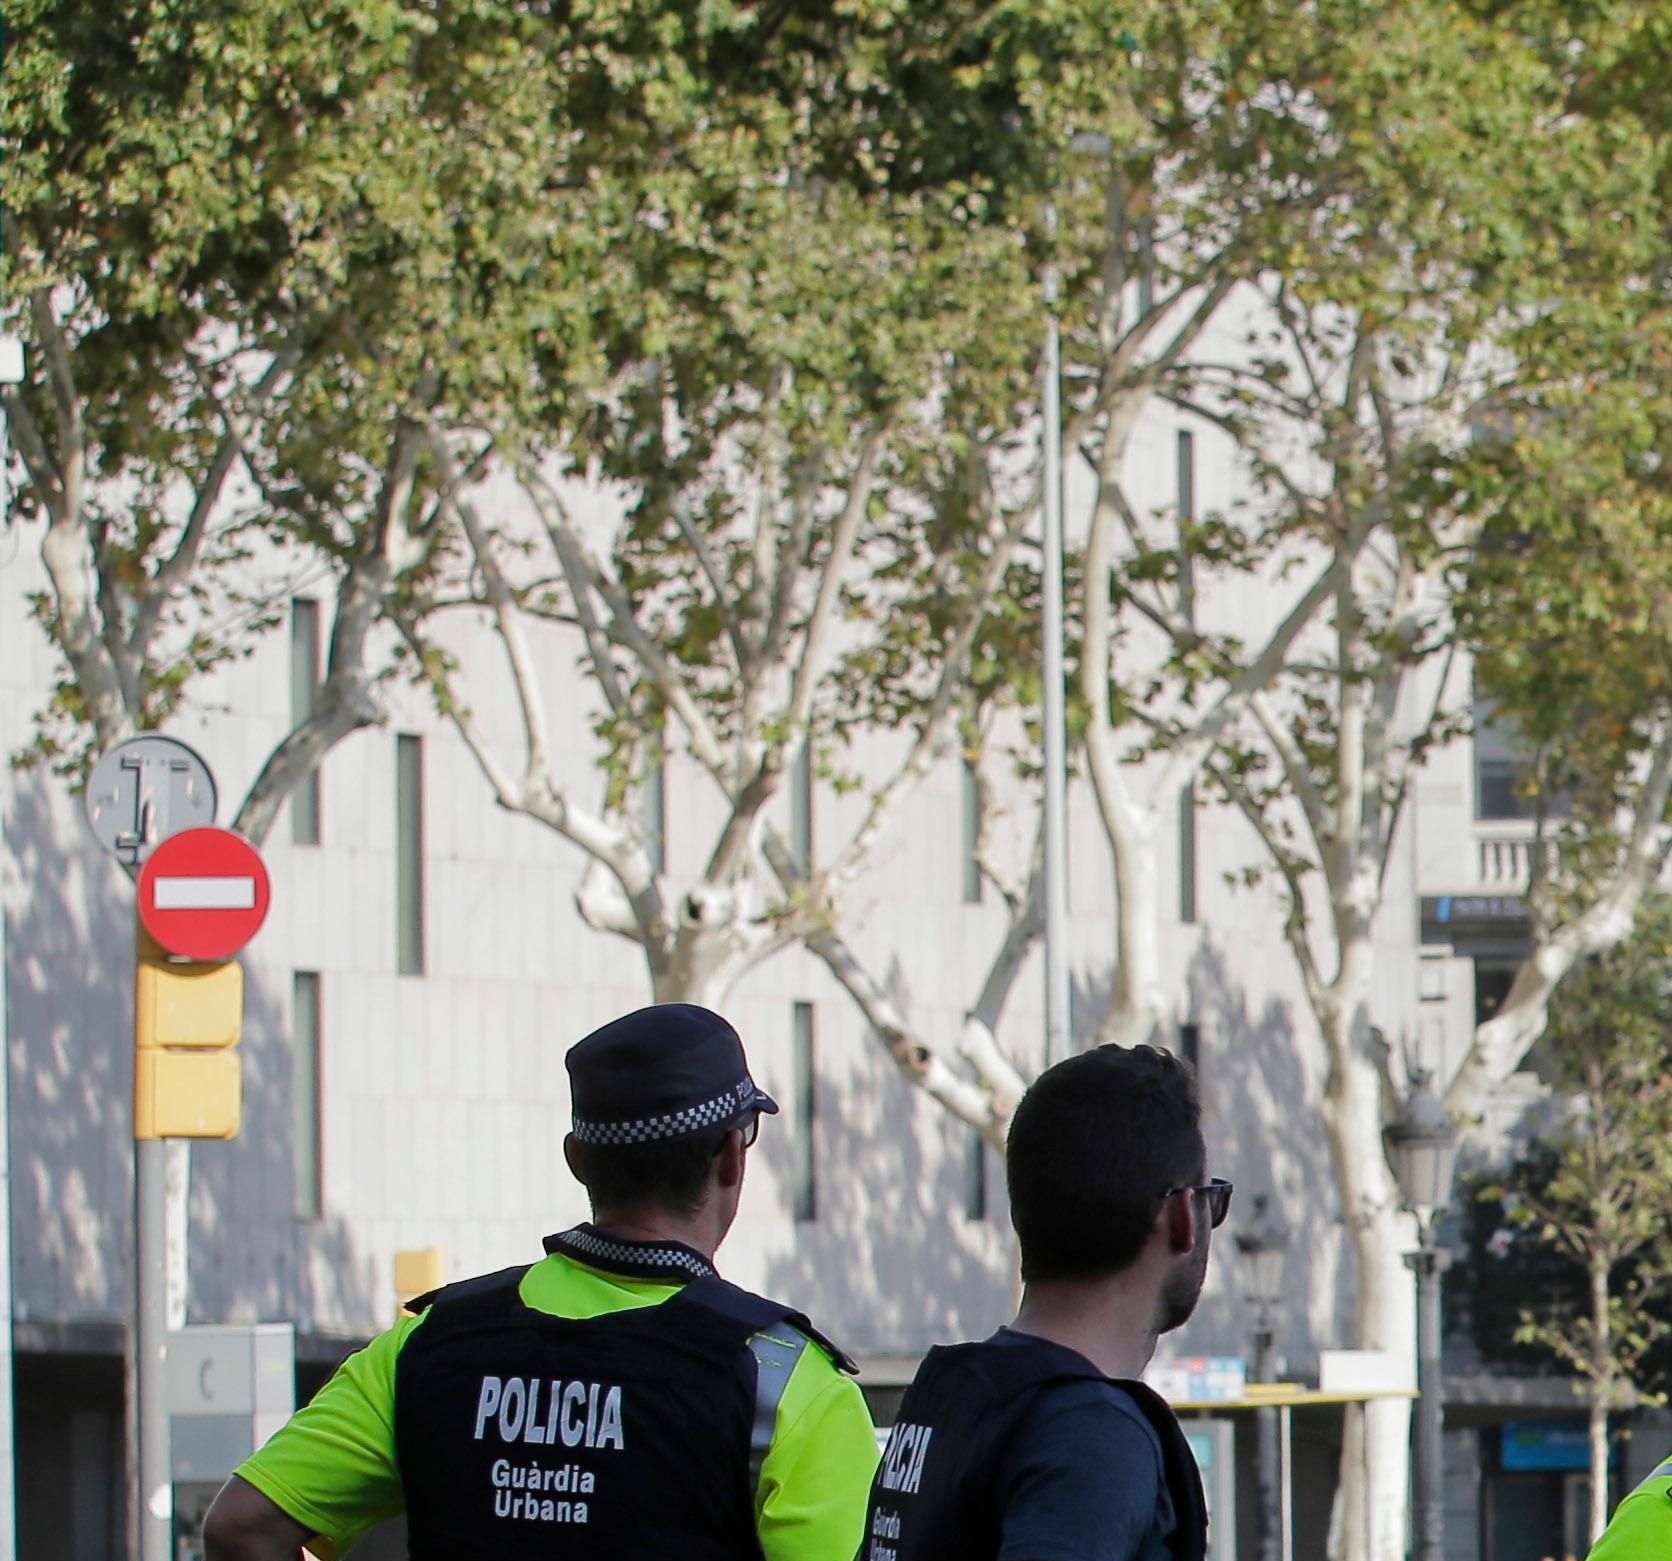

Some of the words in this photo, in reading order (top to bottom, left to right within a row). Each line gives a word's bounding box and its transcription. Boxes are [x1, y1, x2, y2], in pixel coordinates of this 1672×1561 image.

[474, 1376, 625, 1450] POLICIA
[491, 1459, 595, 1493] Guàrdia
[494, 1490, 589, 1523] Urbana
